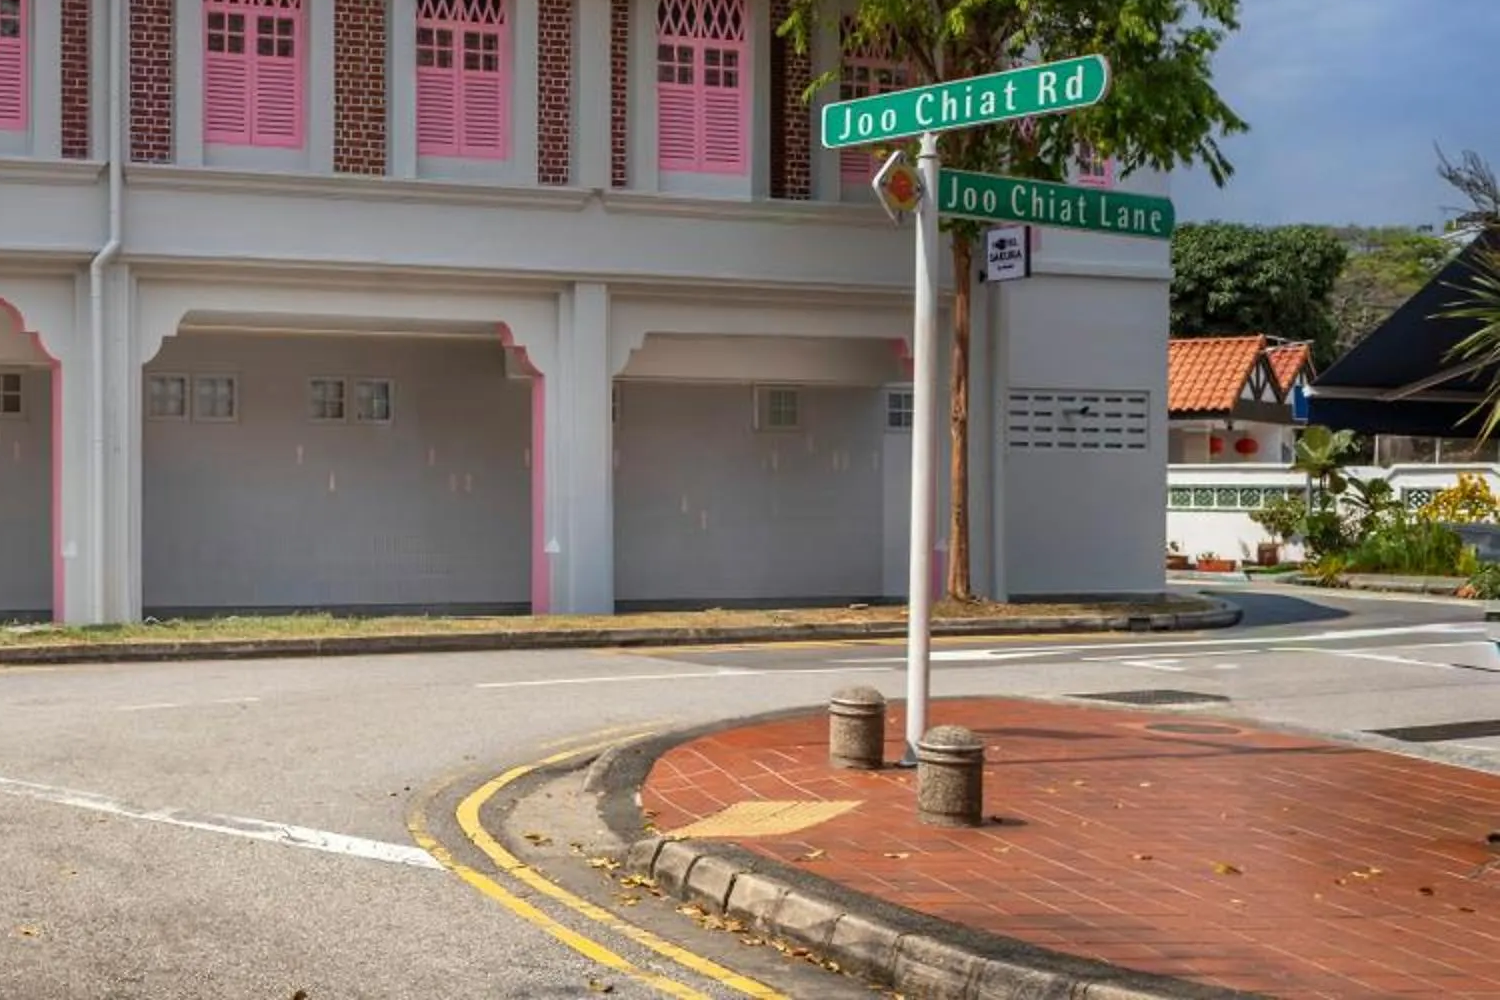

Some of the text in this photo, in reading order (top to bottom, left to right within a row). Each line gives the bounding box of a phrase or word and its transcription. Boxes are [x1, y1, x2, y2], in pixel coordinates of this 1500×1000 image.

[838, 65, 1084, 140] Joo Chiat Rd
[947, 176, 1163, 233] Joo Chiat Lane
